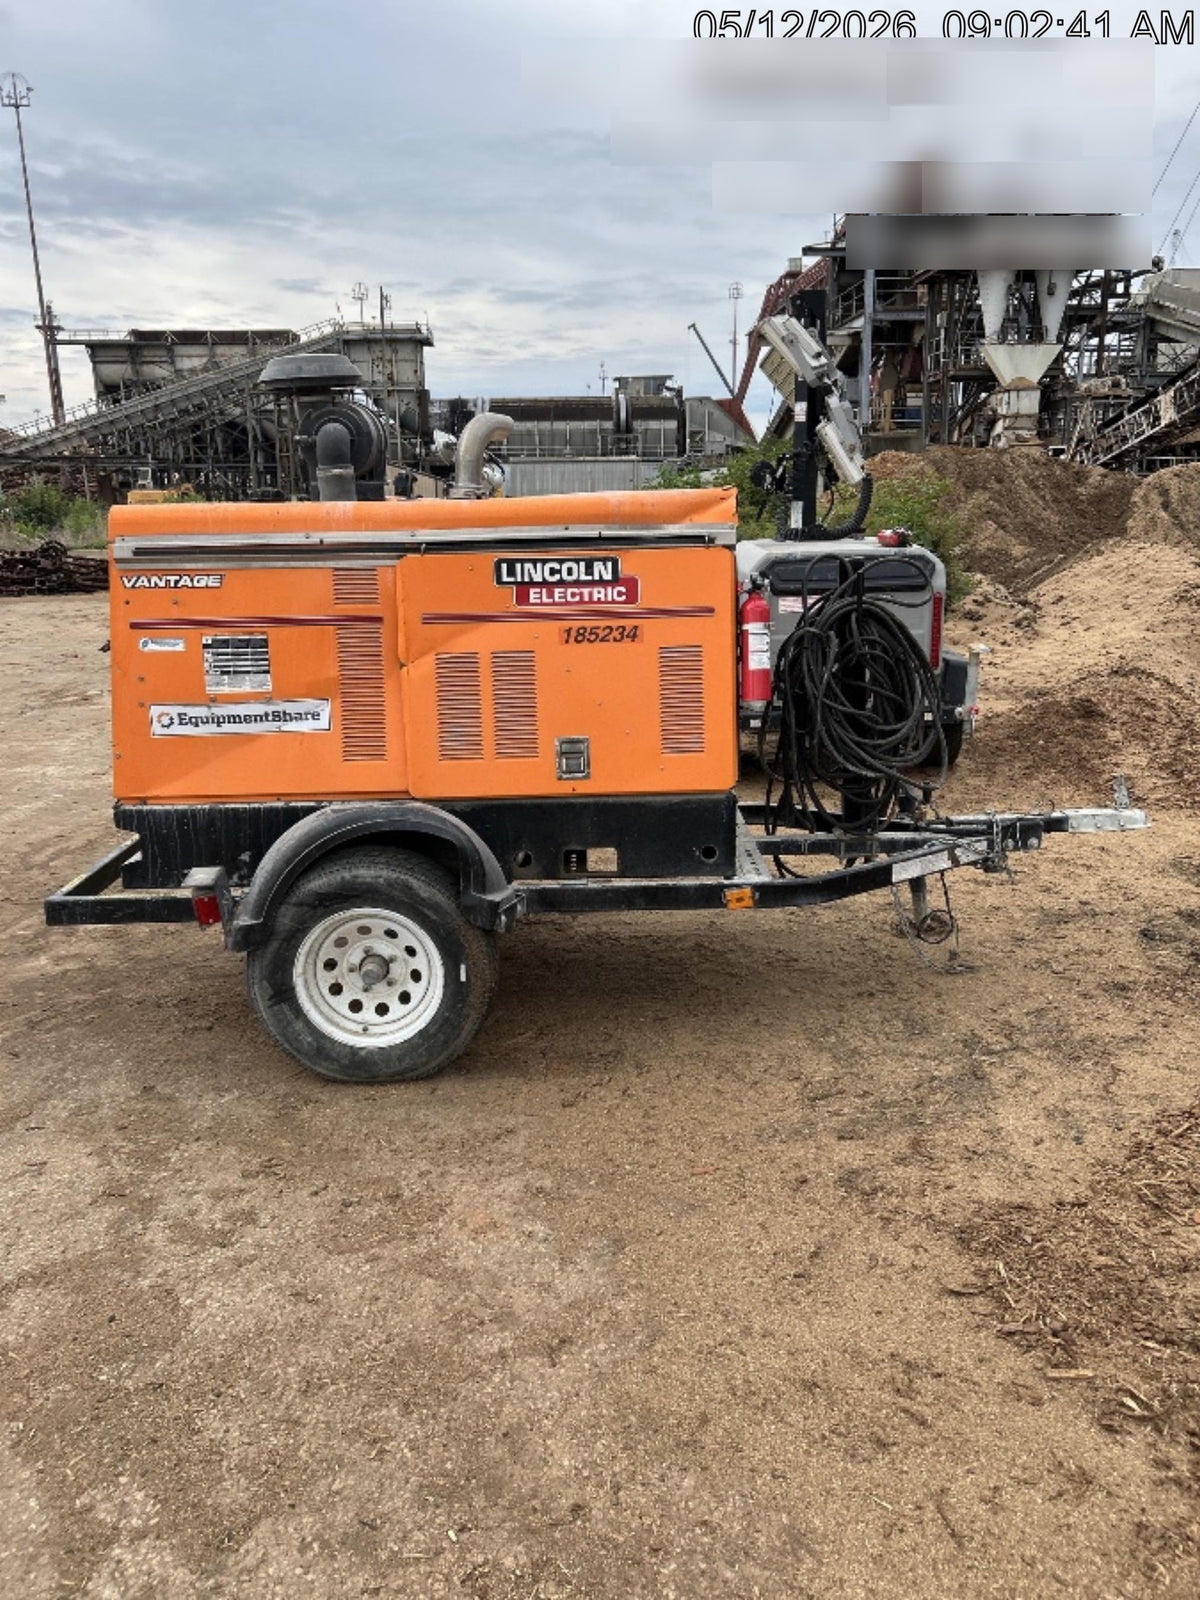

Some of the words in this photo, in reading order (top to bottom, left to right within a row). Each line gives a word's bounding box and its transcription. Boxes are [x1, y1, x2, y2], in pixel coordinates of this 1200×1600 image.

[121, 574, 222, 588] VANTAGE
[500, 560, 613, 583] LINCOLN
[528, 586, 627, 604] ELECTRIC
[562, 625, 640, 644] 185234
[177, 709, 321, 728] EquipmentShare
